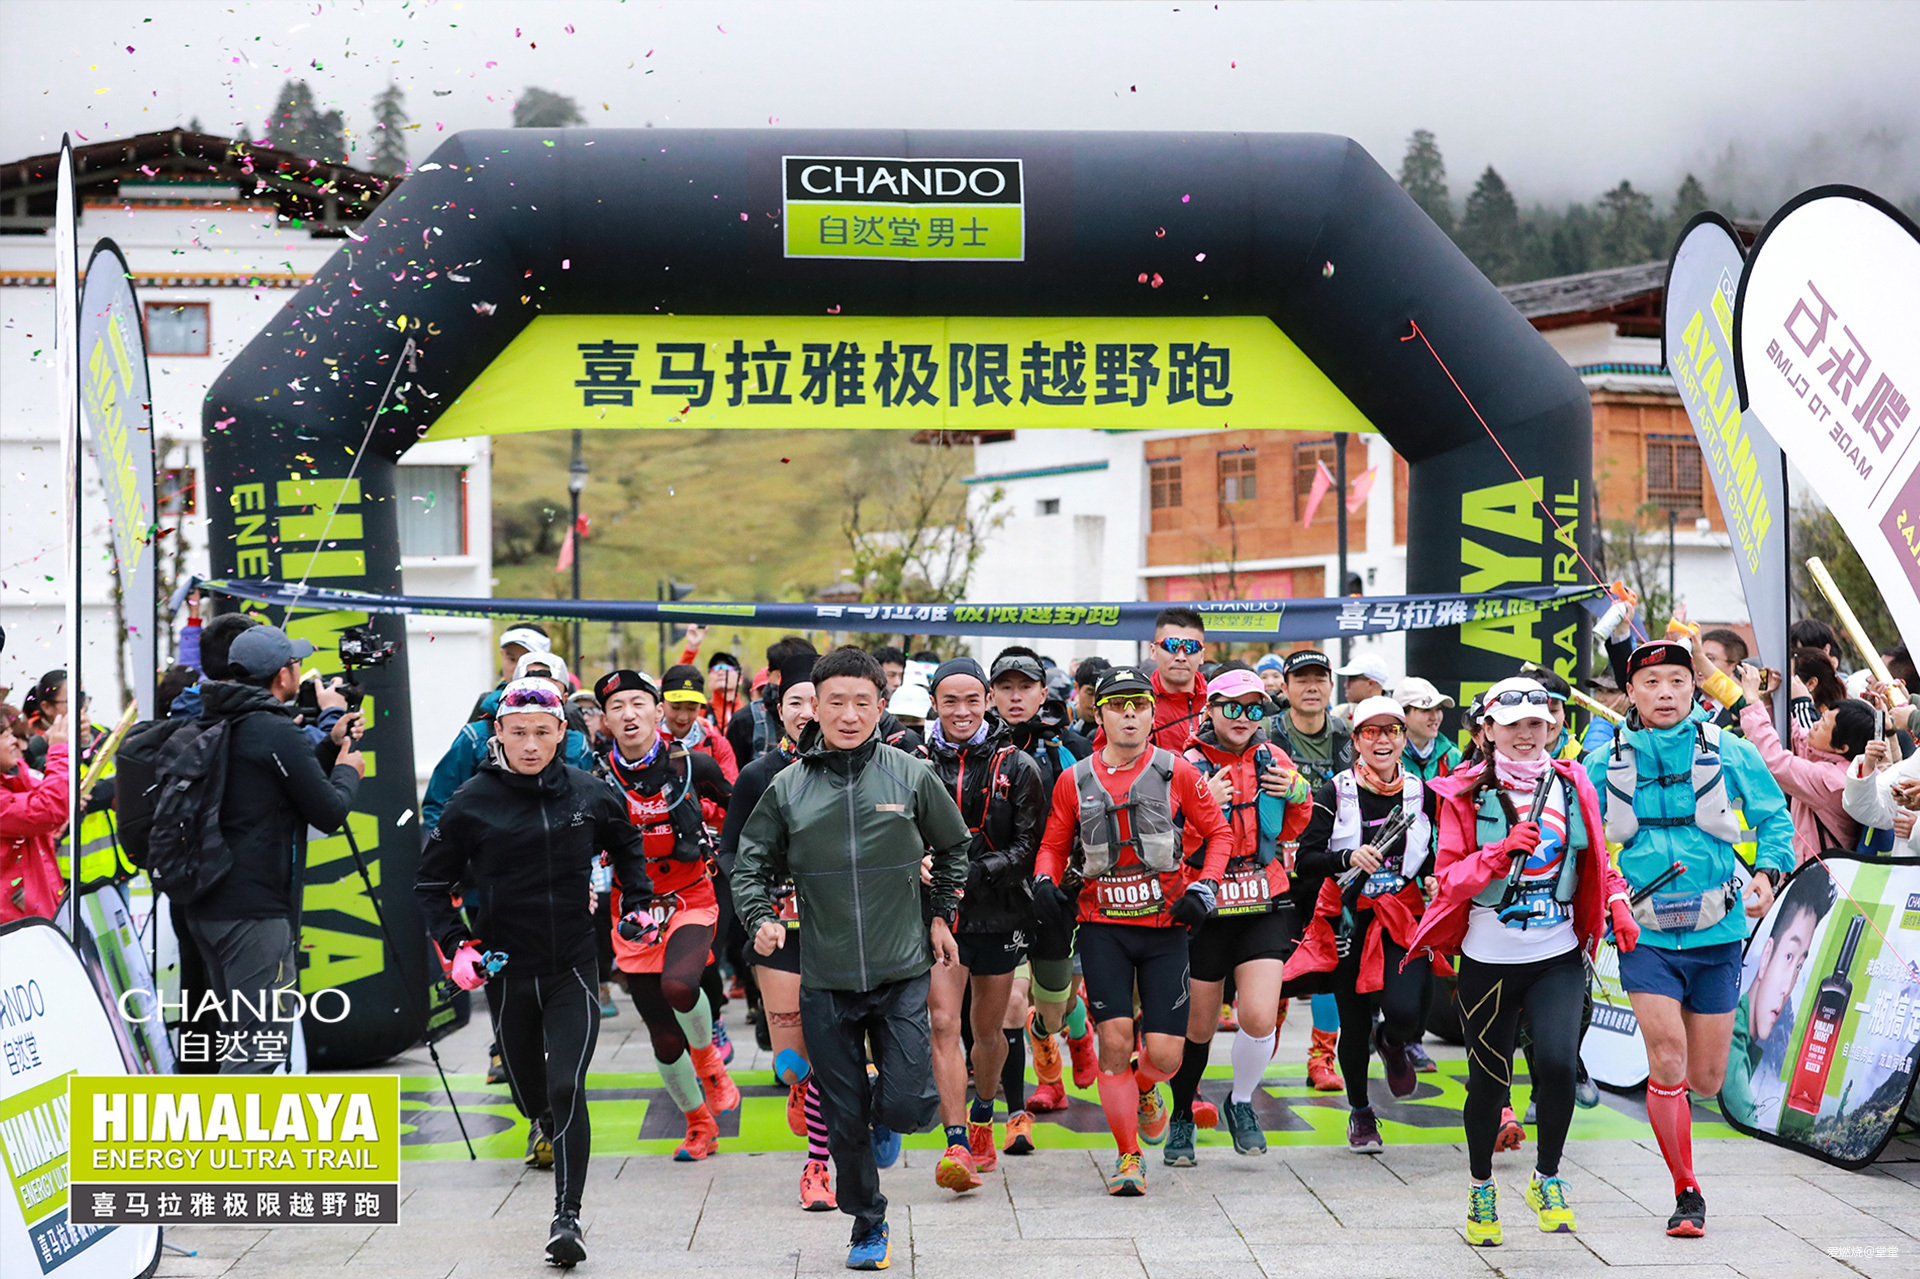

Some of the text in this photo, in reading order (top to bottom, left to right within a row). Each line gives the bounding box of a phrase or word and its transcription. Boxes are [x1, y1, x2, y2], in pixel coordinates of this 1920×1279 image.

[800, 162, 1006, 198] CHANDO
[818, 214, 990, 249] 自然堂男士
[574, 339, 1234, 408] 喜马拉雅极限越野跑
[1554, 479, 1578, 590] RAIL
[1104, 882, 1150, 903] 1008
[1220, 880, 1259, 900] 1018
[4, 1031, 42, 1075] 自然堂
[0, 1092, 68, 1178] HIMALA
[20, 1169, 57, 1210] ENERGY
